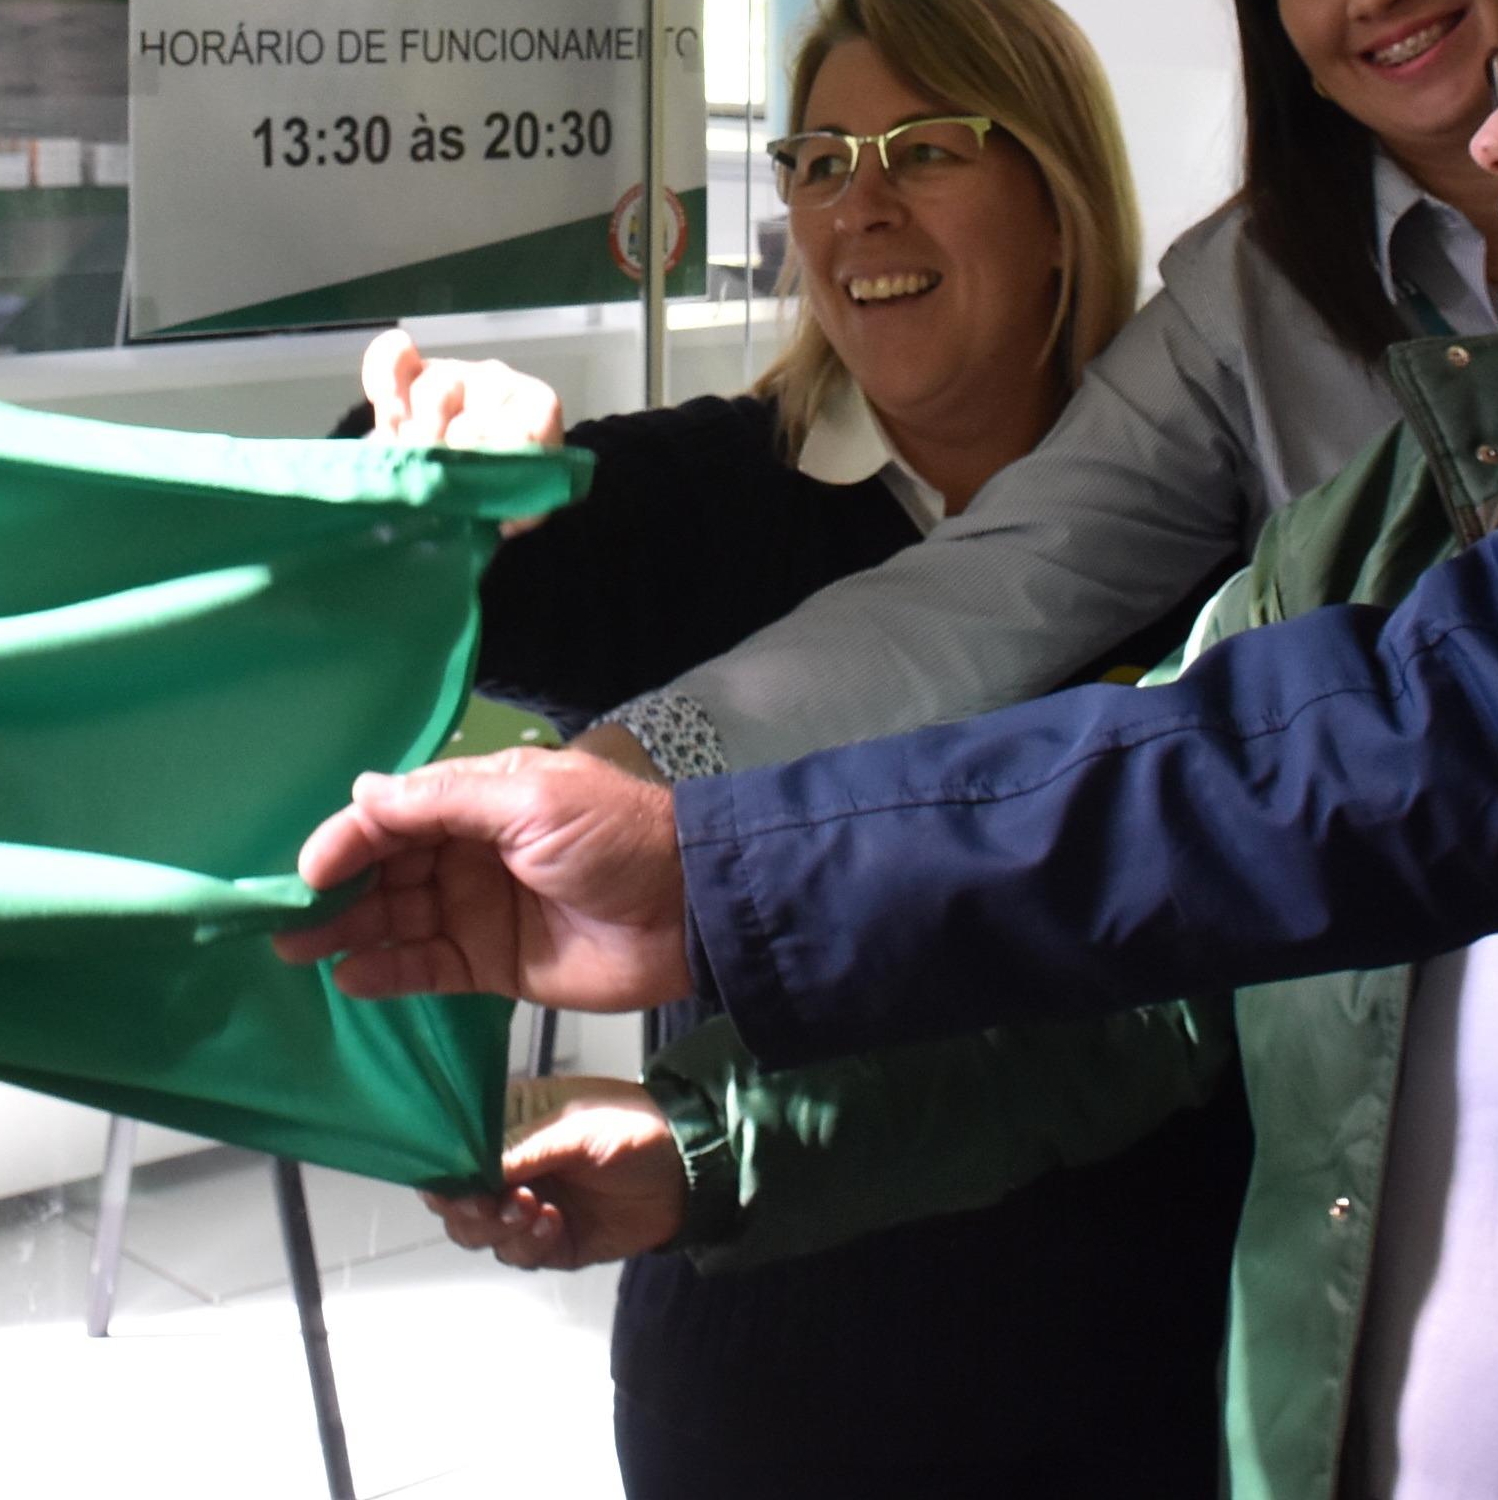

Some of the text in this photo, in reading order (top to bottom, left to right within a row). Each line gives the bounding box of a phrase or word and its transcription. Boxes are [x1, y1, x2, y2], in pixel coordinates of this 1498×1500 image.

[140, 21, 324, 67] HORÁRIO
[338, 29, 387, 64] DE
[253, 107, 613, 167] 13:30 às 20:30
